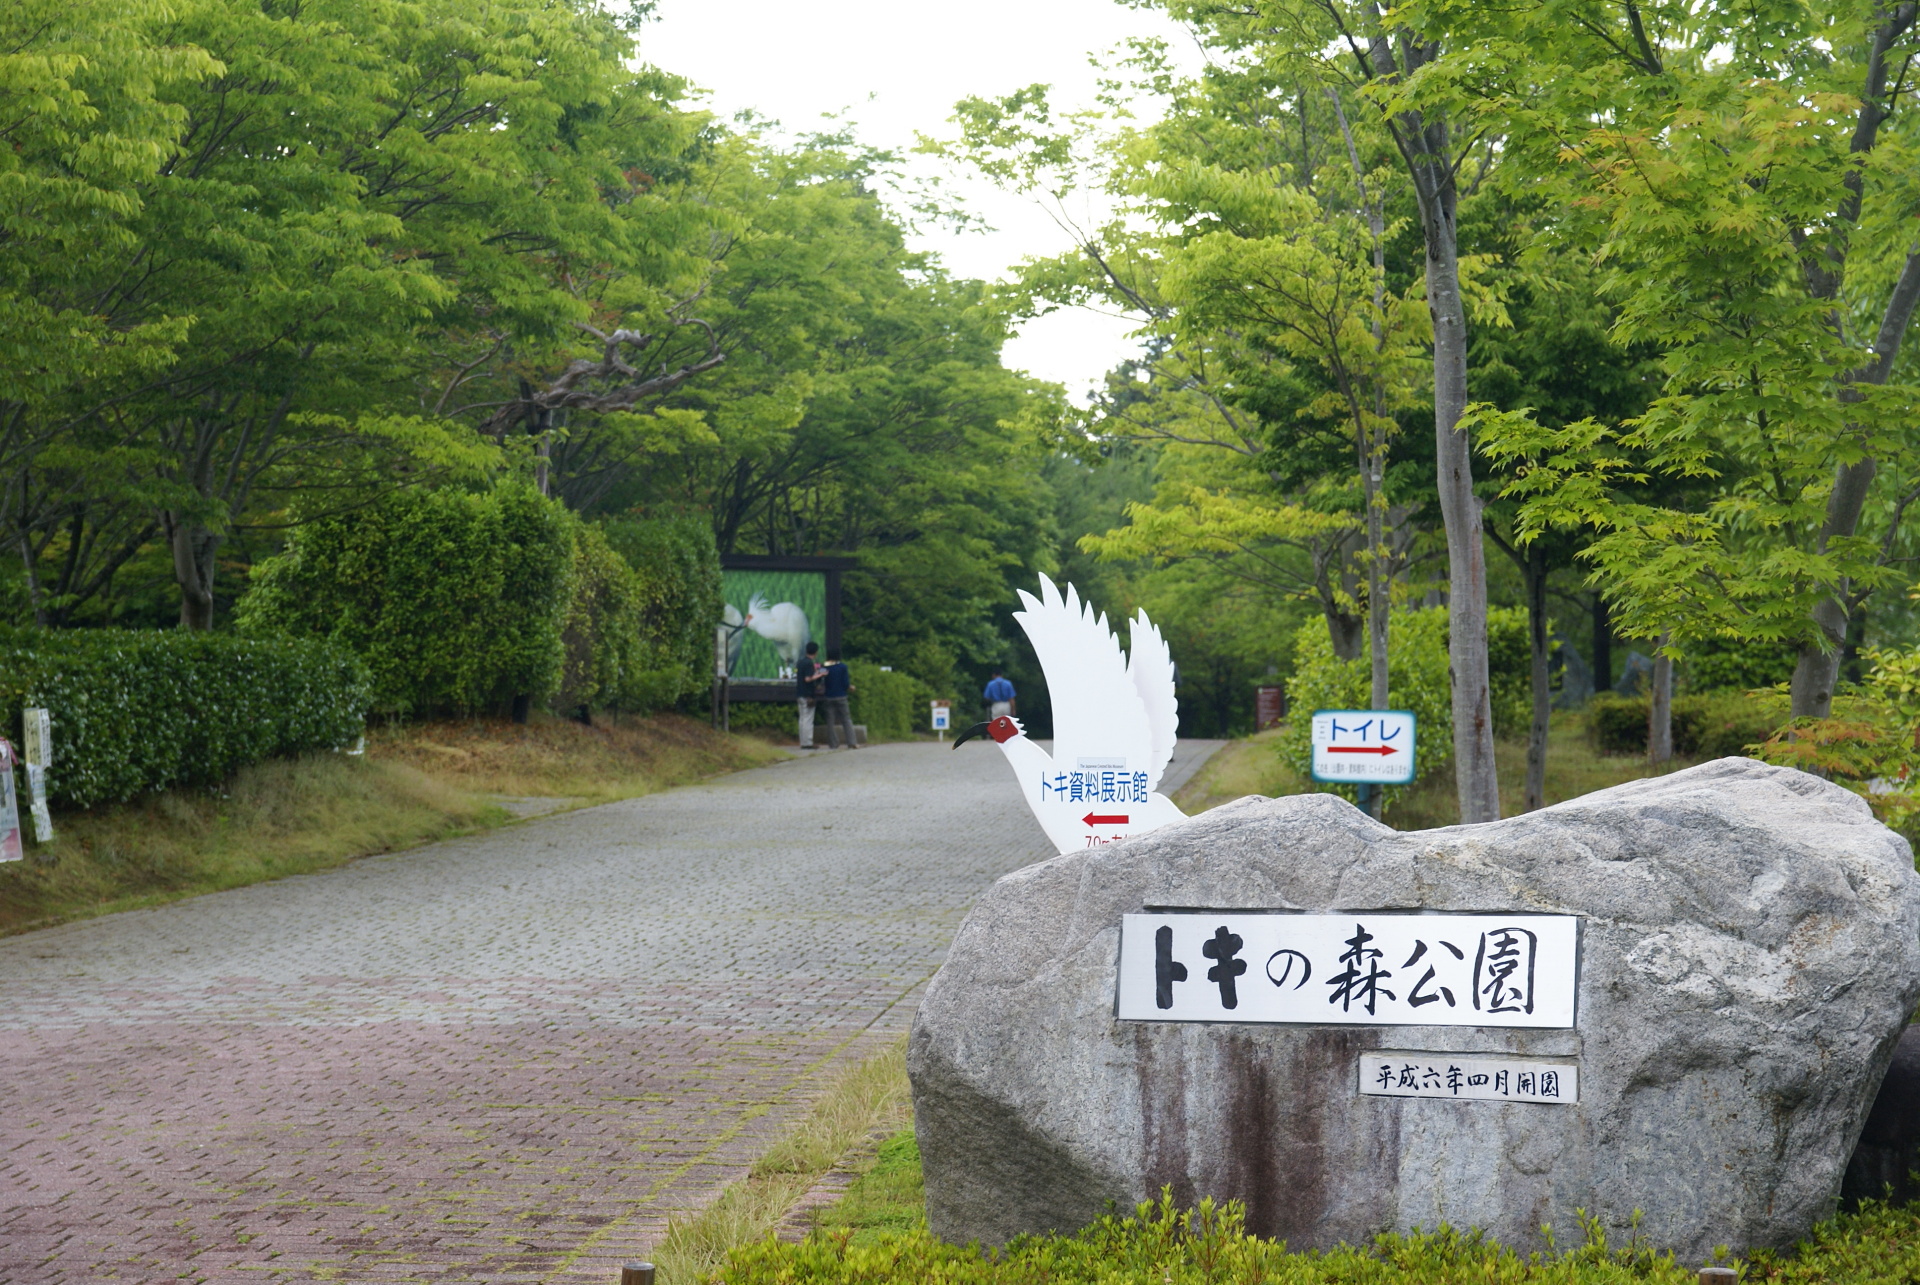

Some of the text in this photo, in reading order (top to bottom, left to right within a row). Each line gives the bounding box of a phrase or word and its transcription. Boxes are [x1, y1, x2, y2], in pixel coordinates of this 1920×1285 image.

[1332, 718, 1401, 742] トイレ
[1042, 771, 1149, 803] トキ資料展示館
[1155, 924, 1537, 1016] トキの森公園
[1376, 1063, 1560, 1098] 平成六年四月開園
